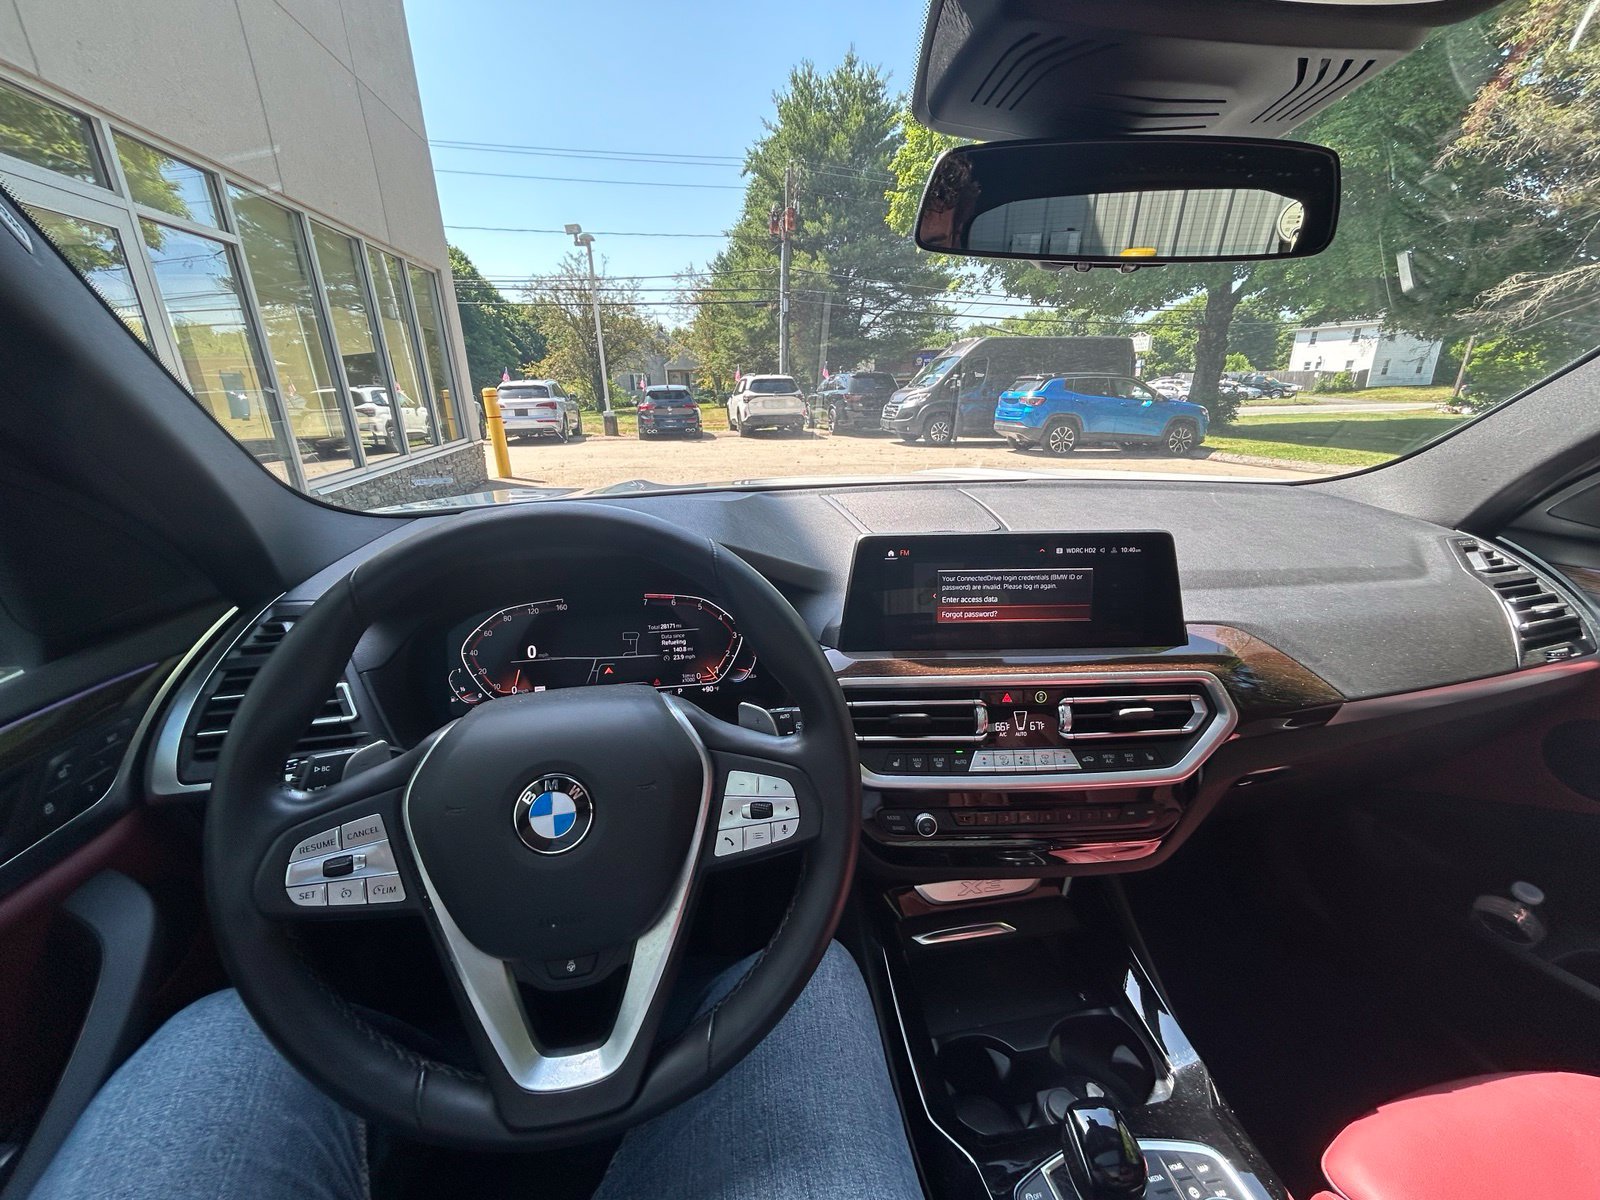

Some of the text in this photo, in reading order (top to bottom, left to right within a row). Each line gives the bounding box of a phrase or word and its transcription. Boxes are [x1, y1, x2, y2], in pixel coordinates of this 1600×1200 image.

[1002, 574, 1017, 583] login
[1050, 573, 1068, 582] (BMW
[983, 595, 998, 603] data
[942, 610, 997, 619] Forgot password?
[527, 645, 537, 658] 0
[511, 686, 518, 695] 0
[701, 685, 714, 693] +90
[521, 778, 585, 806] BMW
[347, 826, 380, 841] CANCEL
[299, 839, 336, 854] RESUME
[382, 886, 397, 895] LIM
[957, 879, 1005, 896] X3
[299, 890, 316, 900] SET
[1168, 1162, 1184, 1171] HOME
[1147, 1173, 1164, 1183] MEDIA
